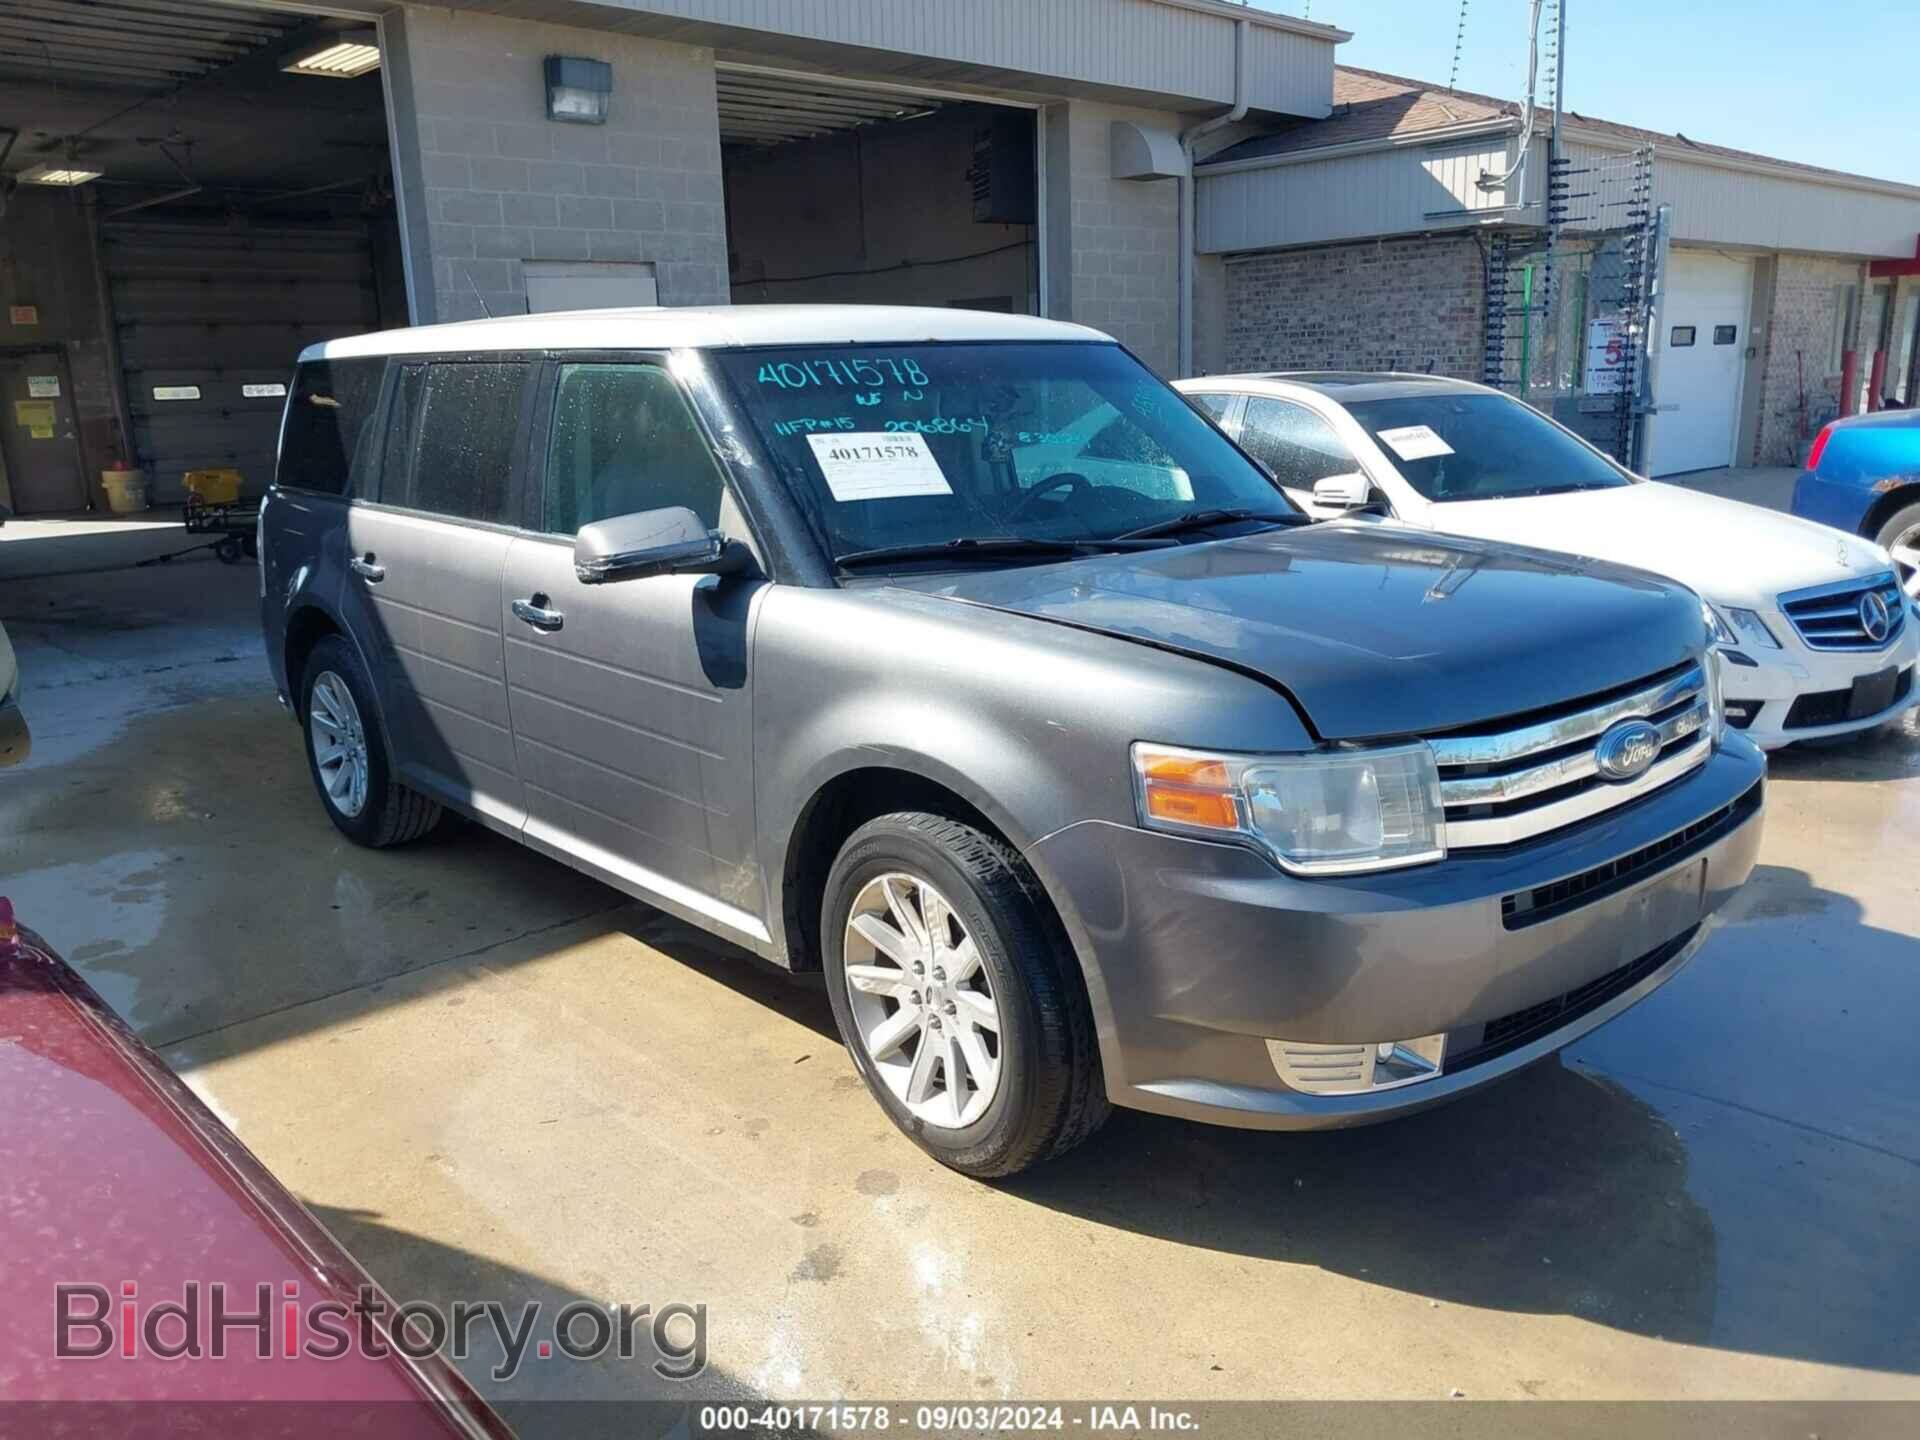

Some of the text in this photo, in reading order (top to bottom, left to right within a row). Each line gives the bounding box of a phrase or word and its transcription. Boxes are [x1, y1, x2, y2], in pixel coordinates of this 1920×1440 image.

[758, 358, 929, 388] 40171578
[829, 446, 919, 460] 40171578
[1622, 733, 1654, 767] Ford
